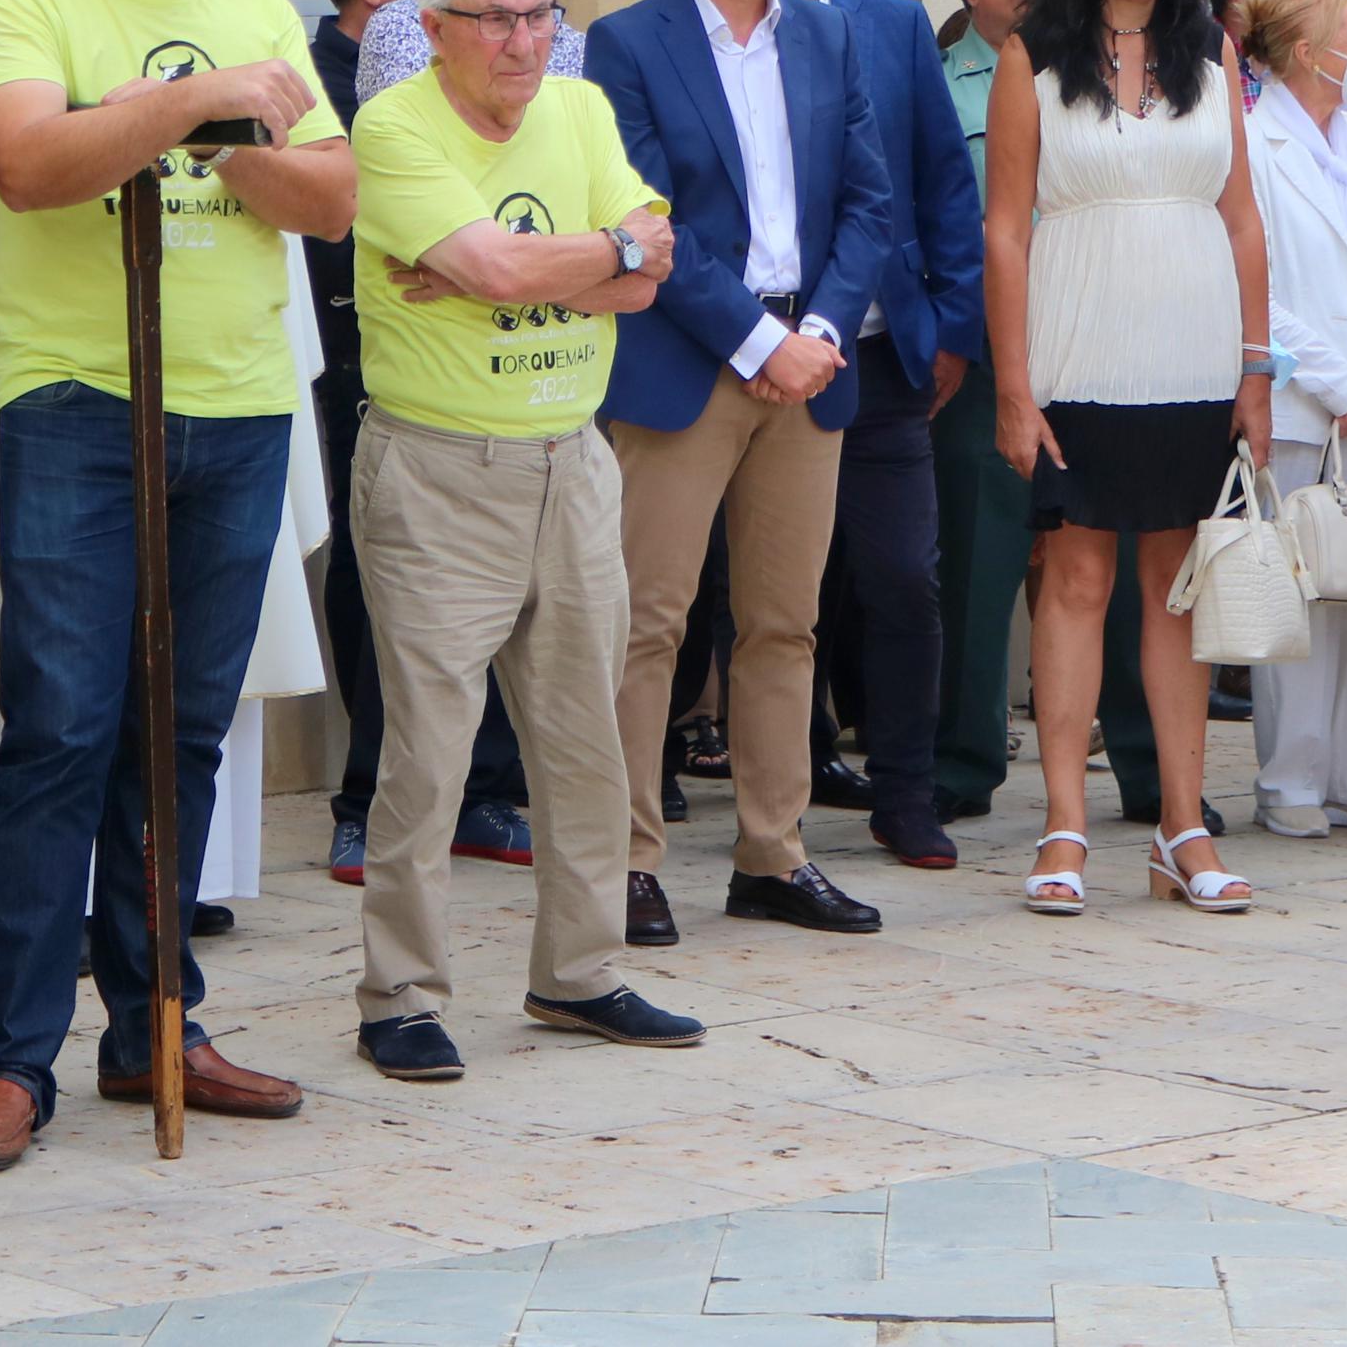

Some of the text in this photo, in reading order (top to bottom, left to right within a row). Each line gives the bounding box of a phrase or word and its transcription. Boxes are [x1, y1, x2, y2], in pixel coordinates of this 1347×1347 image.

[162, 221, 218, 250] 022
[488, 342, 597, 375] TORQUEMADA
[527, 374, 580, 407] 2022
